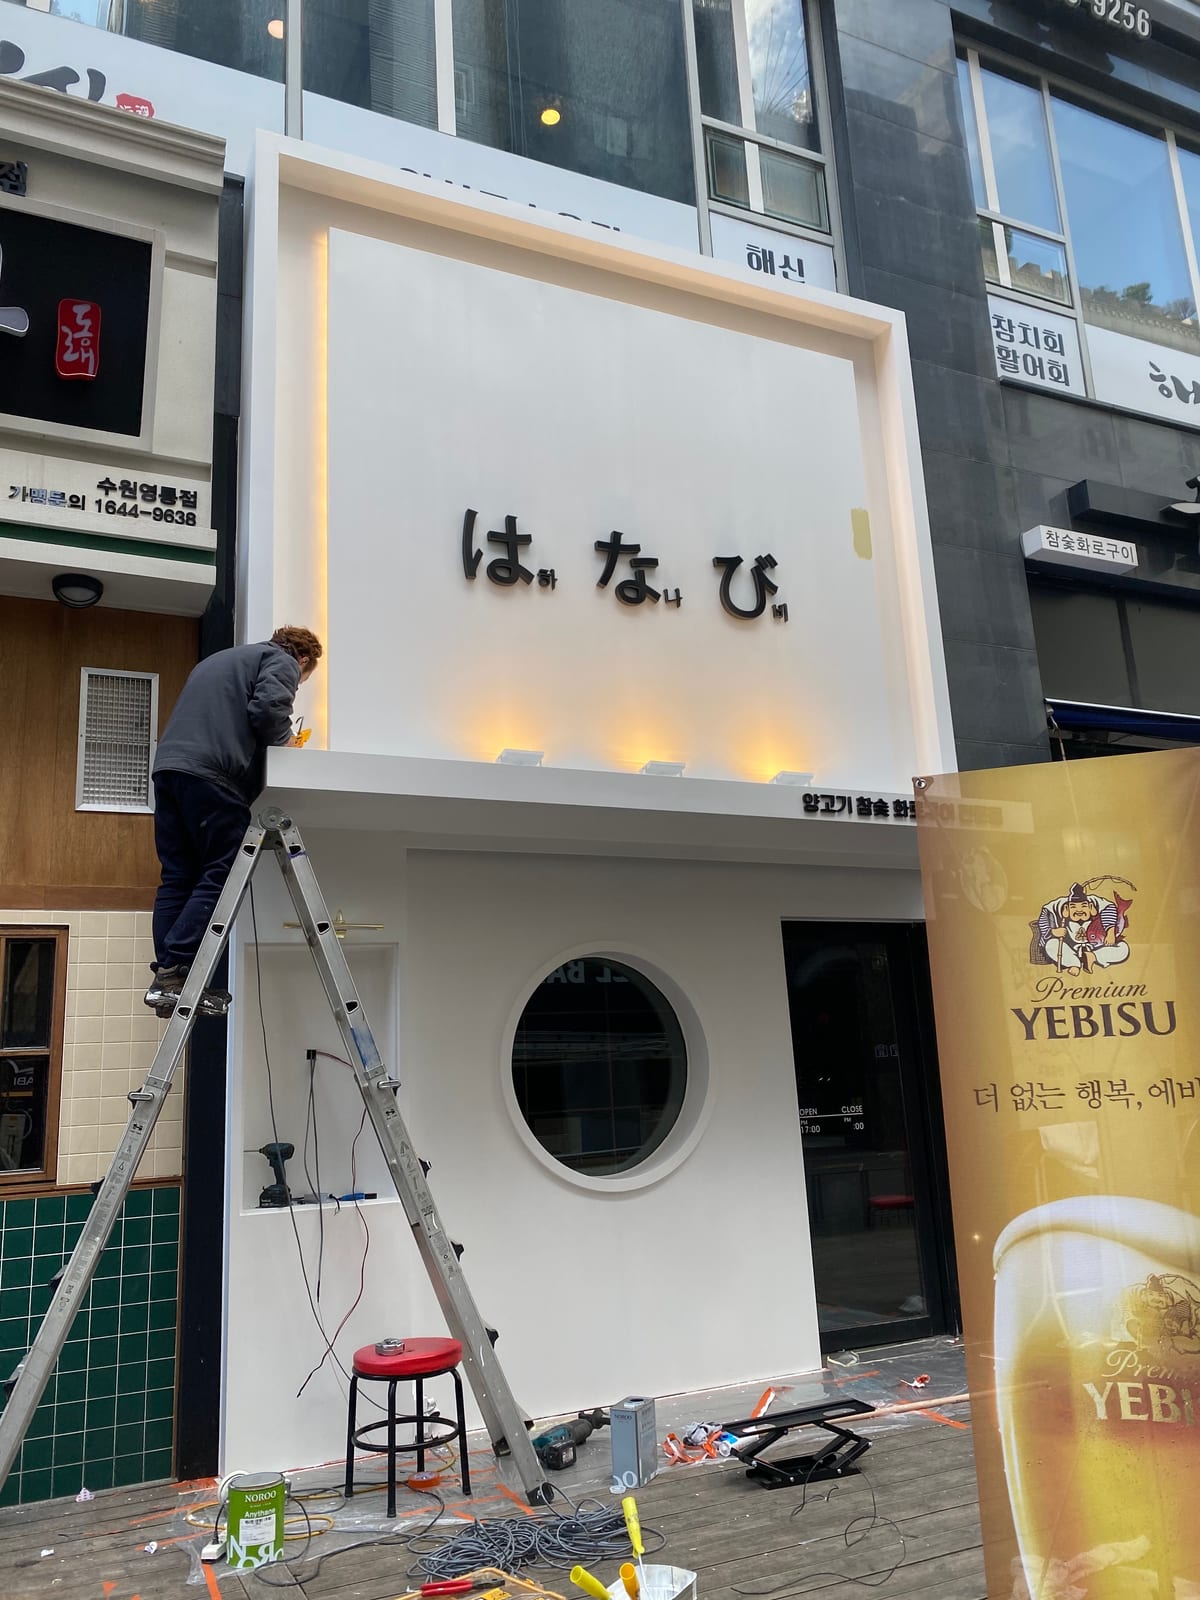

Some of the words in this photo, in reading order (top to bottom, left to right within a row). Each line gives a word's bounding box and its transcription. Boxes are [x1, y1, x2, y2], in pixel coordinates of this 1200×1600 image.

[746, 244, 806, 284] 해신
[992, 314, 1065, 356] 참치회
[996, 345, 1070, 386] 활어회
[97, 477, 198, 509] 수원영통점
[95, 499, 197, 527] 1644-9638
[1046, 530, 1135, 563] 참숯화로구이
[802, 793, 853, 815] 양고기
[856, 796, 890, 817] 참숯
[1031, 976, 1148, 1003] Premium
[1011, 1001, 1177, 1041] YEBISU
[799, 1108, 818, 1116] OPEN
[841, 1105, 863, 1114] CLOSE
[973, 1083, 999, 1113] 더
[1010, 1082, 1066, 1112] 없는
[1075, 1079, 1143, 1111] 행복,
[1083, 1382, 1200, 1426] YEBI
[244, 1490, 277, 1503] NOROO
